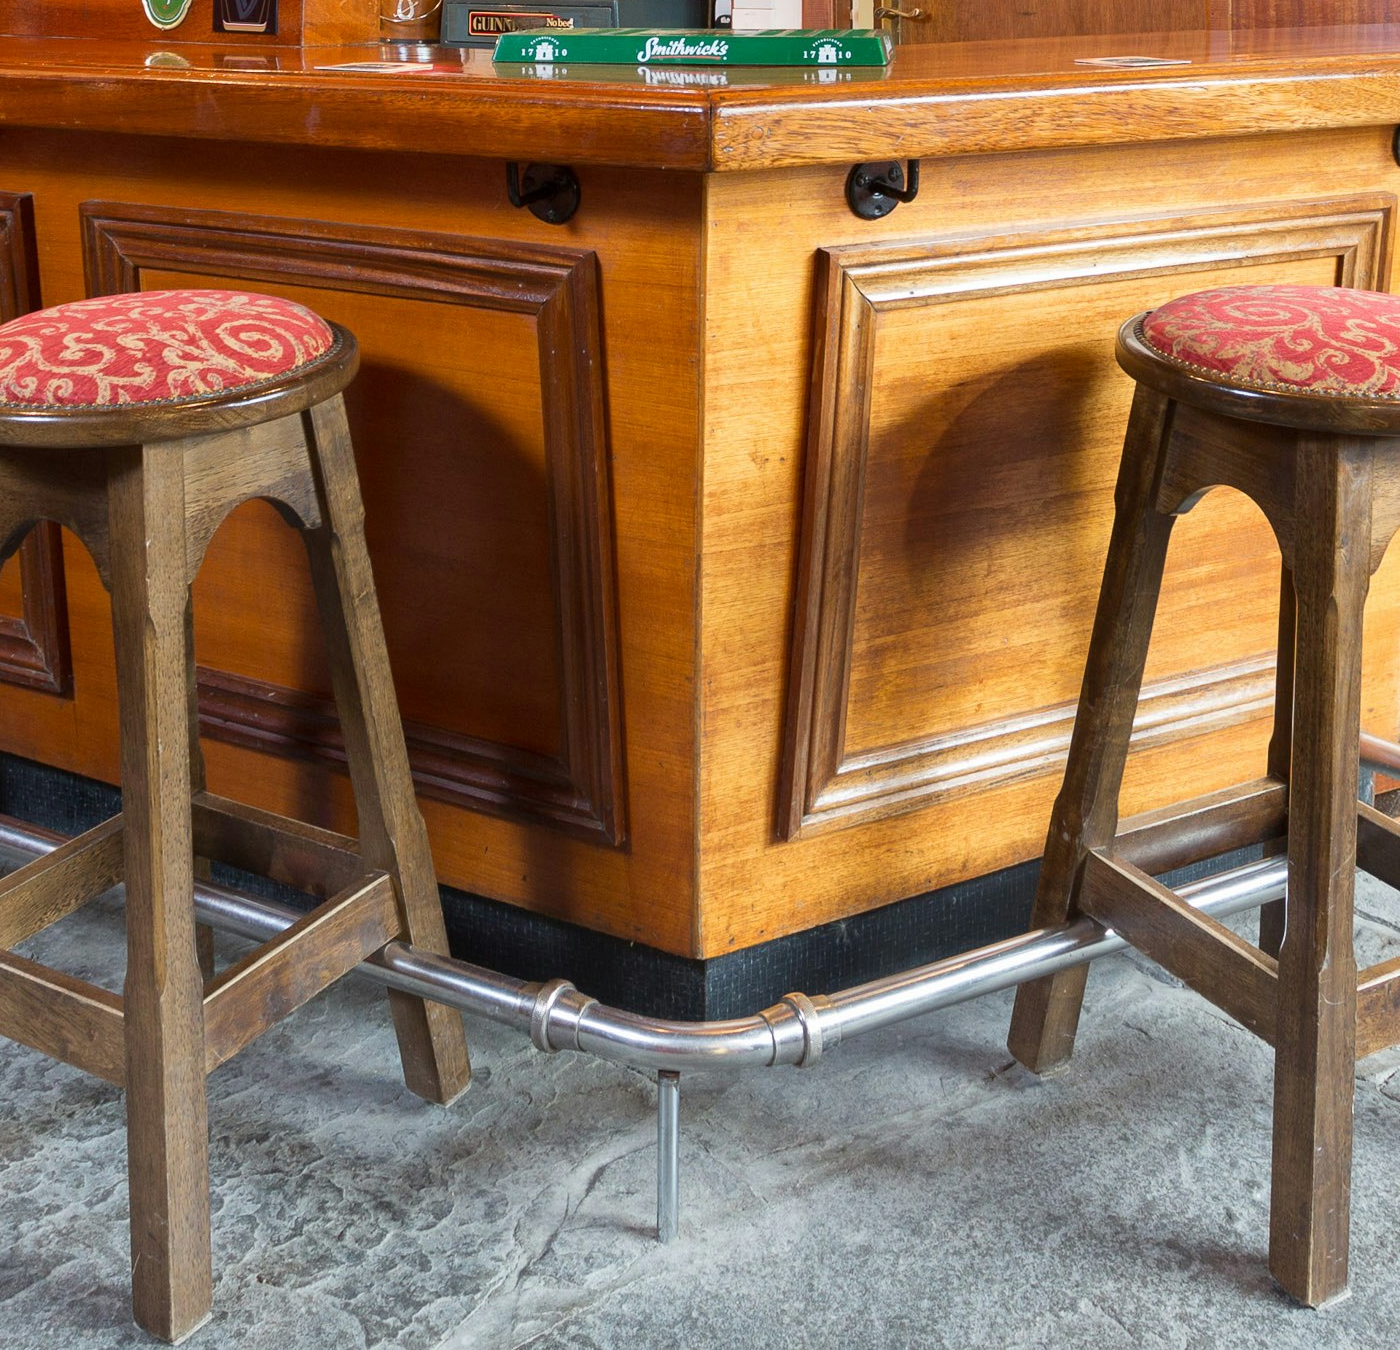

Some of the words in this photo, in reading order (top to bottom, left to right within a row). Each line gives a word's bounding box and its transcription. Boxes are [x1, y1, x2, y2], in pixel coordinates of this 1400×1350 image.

[520, 48, 534, 57] 17
[553, 48, 567, 57] 10
[637, 37, 728, 62] Smithwick's
[802, 50, 816, 60] 17
[838, 51, 852, 60] 10
